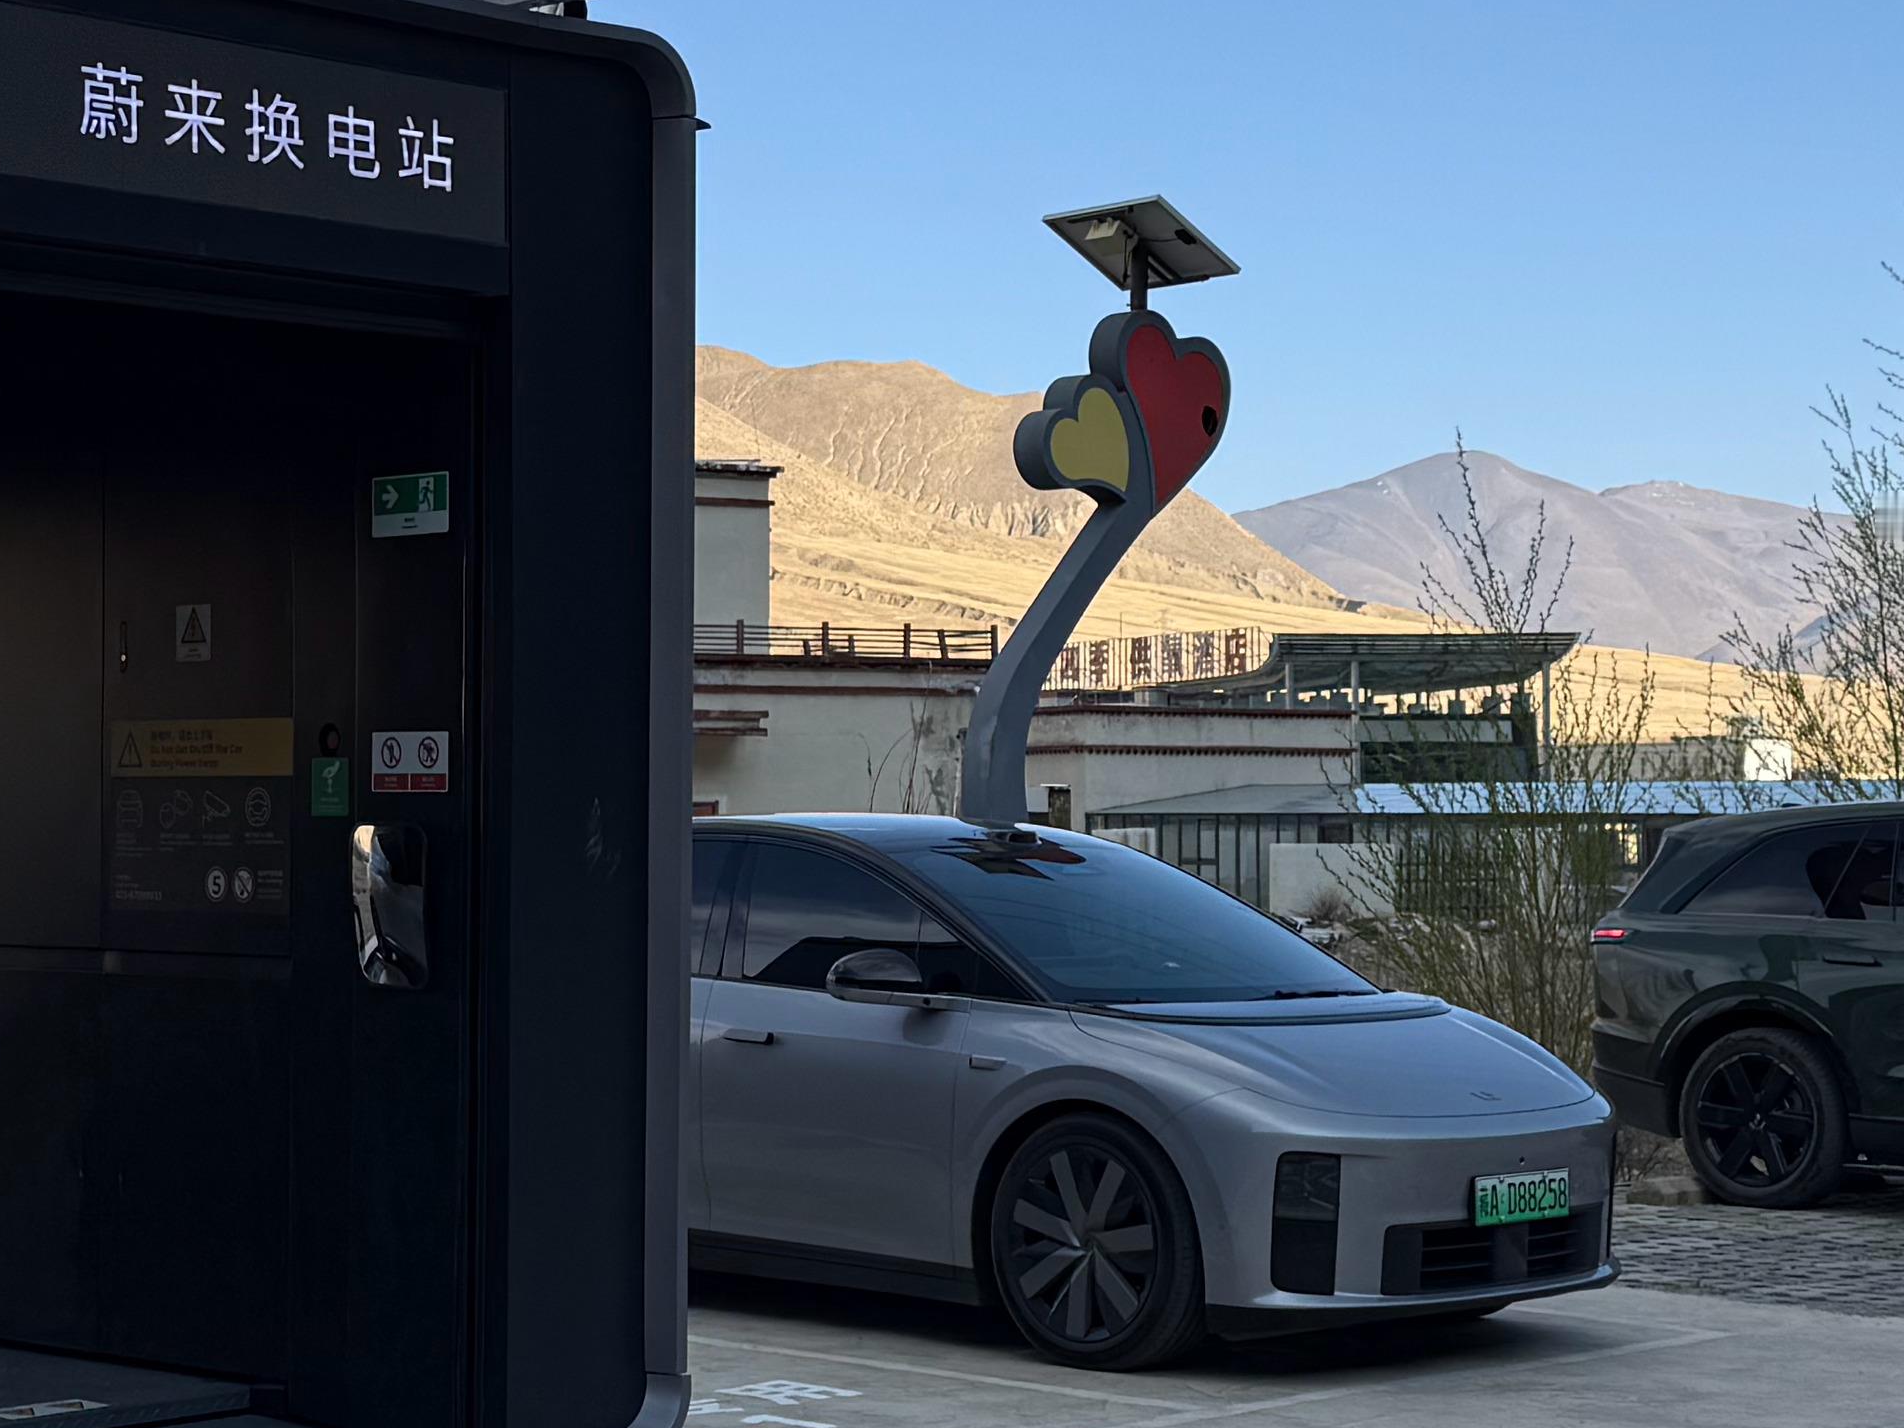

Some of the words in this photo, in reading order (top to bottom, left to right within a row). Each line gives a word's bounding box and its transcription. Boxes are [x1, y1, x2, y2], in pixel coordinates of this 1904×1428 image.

[80, 62, 454, 192] 蔚来换电站
[212, 874, 221, 896] 5
[1507, 1177, 1568, 1215] D88258
